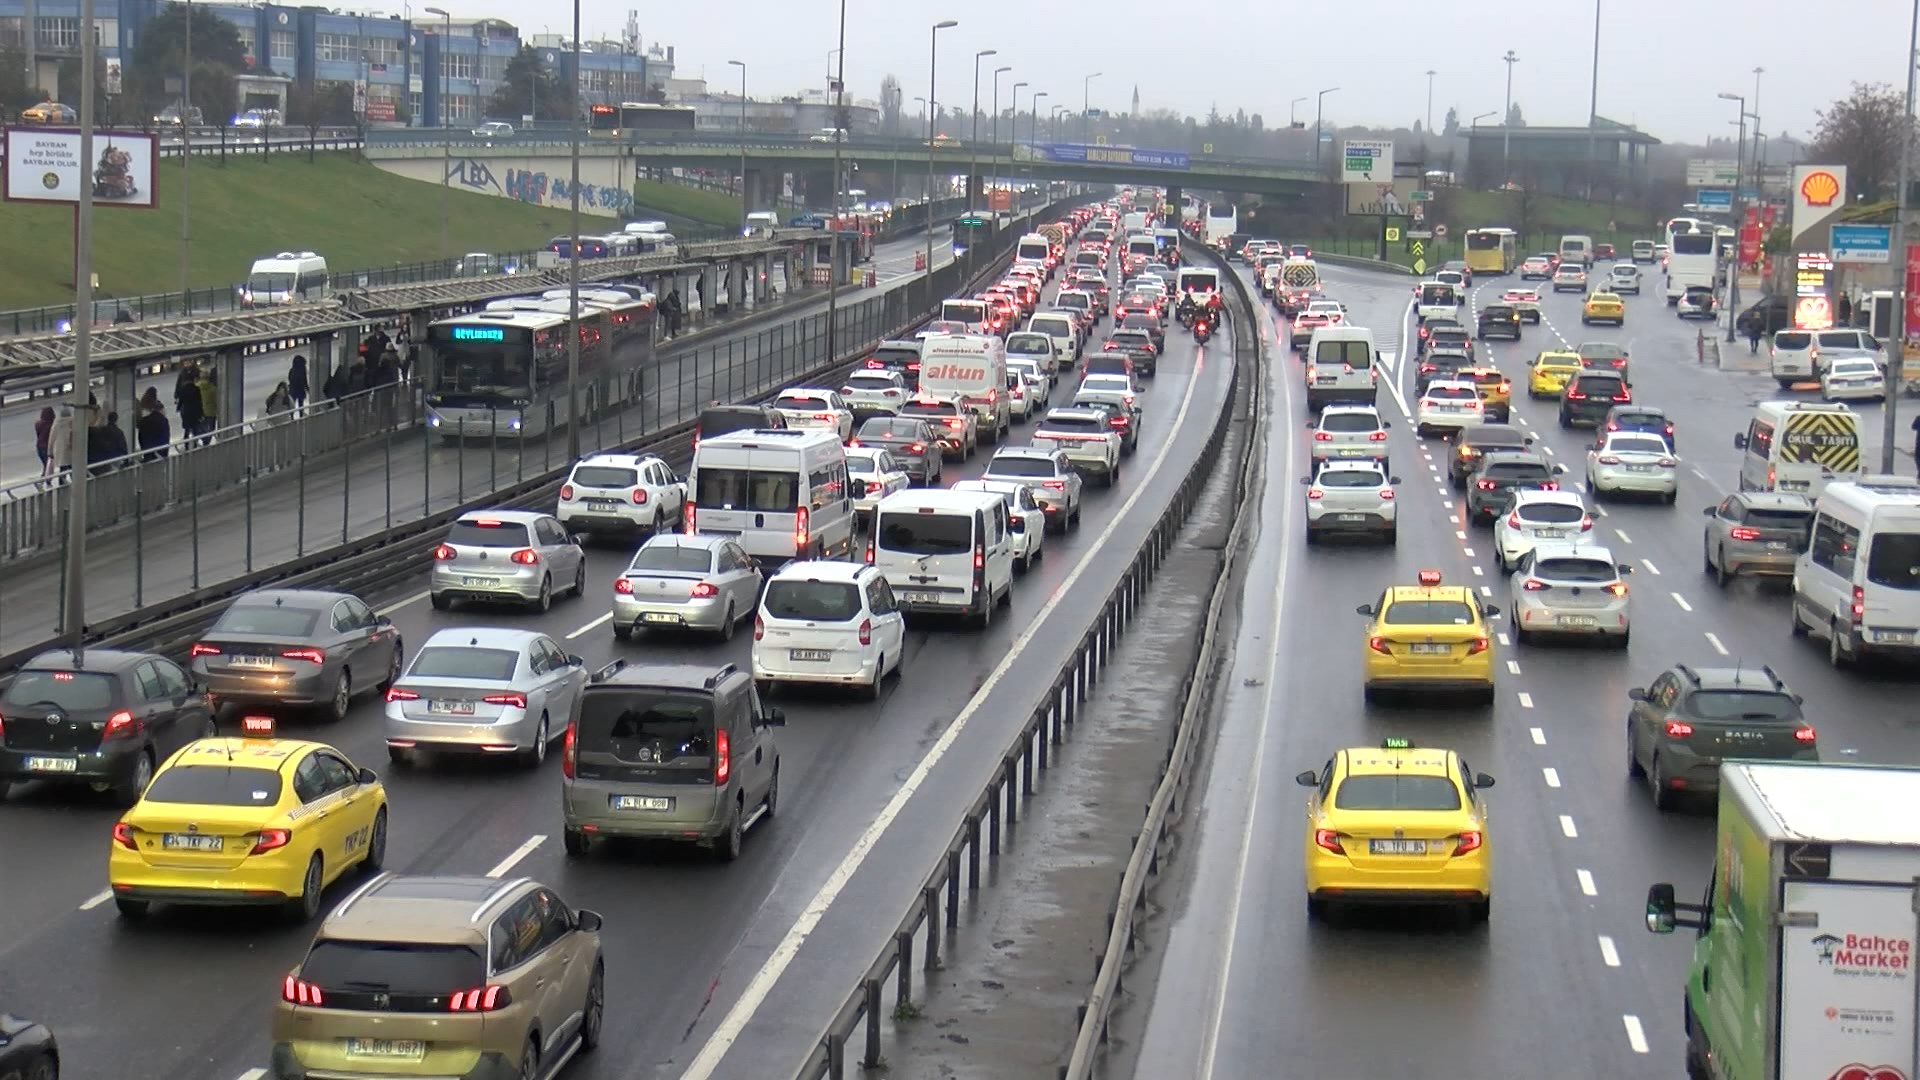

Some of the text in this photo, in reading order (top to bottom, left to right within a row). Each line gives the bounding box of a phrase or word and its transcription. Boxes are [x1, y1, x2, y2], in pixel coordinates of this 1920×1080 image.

[36, 140, 67, 148] BAYRAM
[29, 149, 44, 158] hep
[23, 158, 55, 167] BAYRAM
[927, 364, 985, 380] altun
[1788, 434, 1815, 445] OKUL
[168, 836, 220, 849] 34 TKF 22
[357, 826, 367, 848] 22
[1846, 934, 1909, 953] Bahçe
[1835, 950, 1909, 969] Market
[353, 1041, 366, 1053] 34
